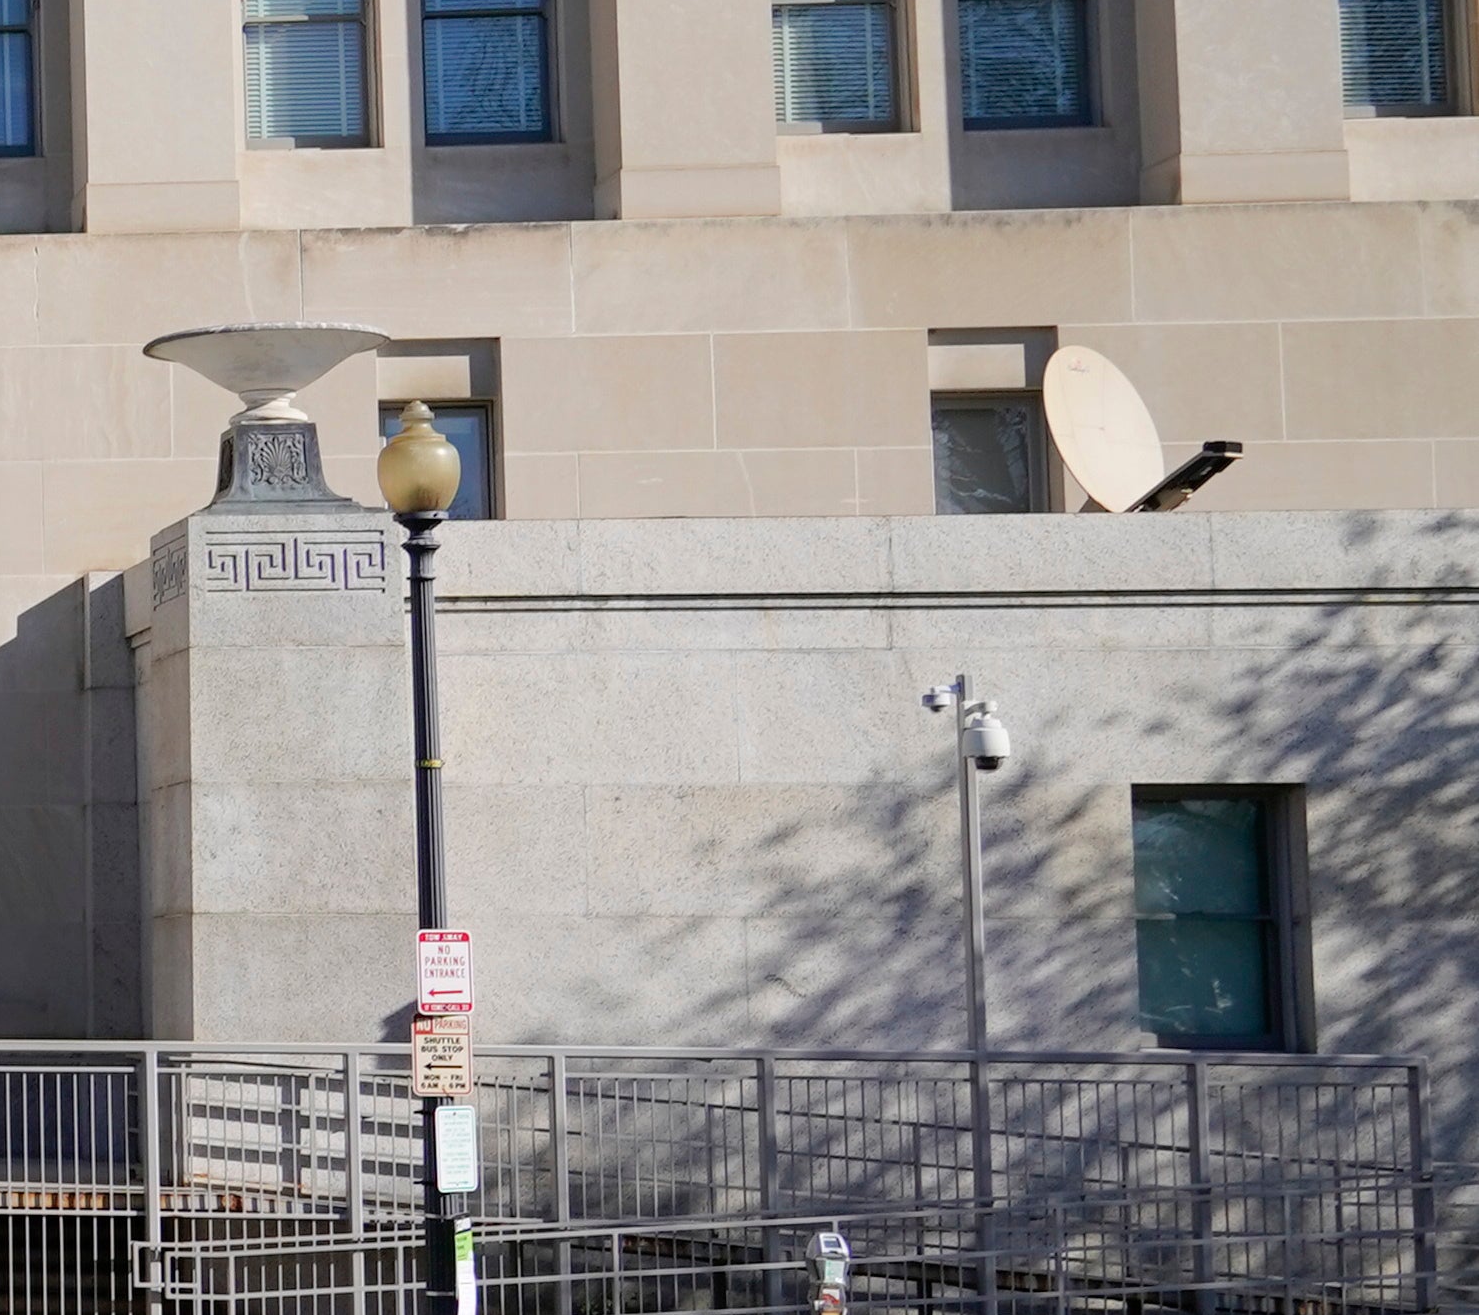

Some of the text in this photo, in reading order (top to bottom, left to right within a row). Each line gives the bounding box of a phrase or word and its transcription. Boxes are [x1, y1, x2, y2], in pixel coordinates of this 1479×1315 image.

[438, 945, 451, 955] NO
[424, 956, 465, 966] PARKING
[424, 968, 465, 979] ENTRANCE
[434, 1019, 467, 1029] PARKING
